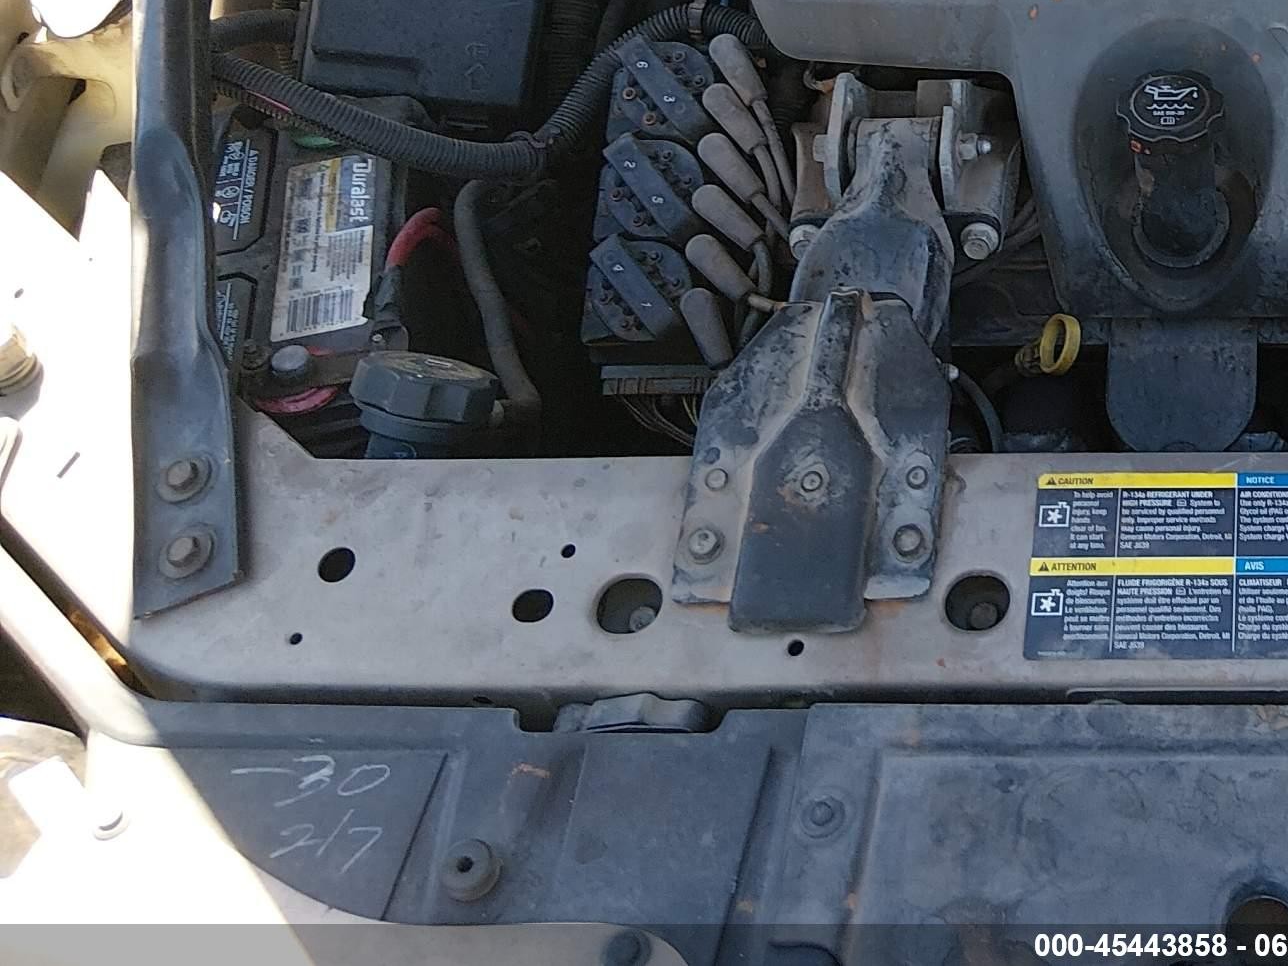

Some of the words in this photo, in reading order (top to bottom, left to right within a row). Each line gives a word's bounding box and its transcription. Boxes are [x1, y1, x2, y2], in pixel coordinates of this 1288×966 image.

[636, 60, 648, 70] 6
[663, 94, 676, 104] 3
[624, 160, 636, 169] 2
[245, 156, 258, 187] DANGER
[349, 158, 373, 223] Duralast
[652, 195, 664, 204] 5
[239, 194, 254, 224] POISON
[612, 264, 625, 273] 4
[1123, 499, 1137, 507] HIGH
[1139, 499, 1171, 507] PRESSURE
[1190, 499, 1212, 507] System
[1051, 563, 1096, 571] ATTENTION
[1245, 562, 1264, 570] AVIS
